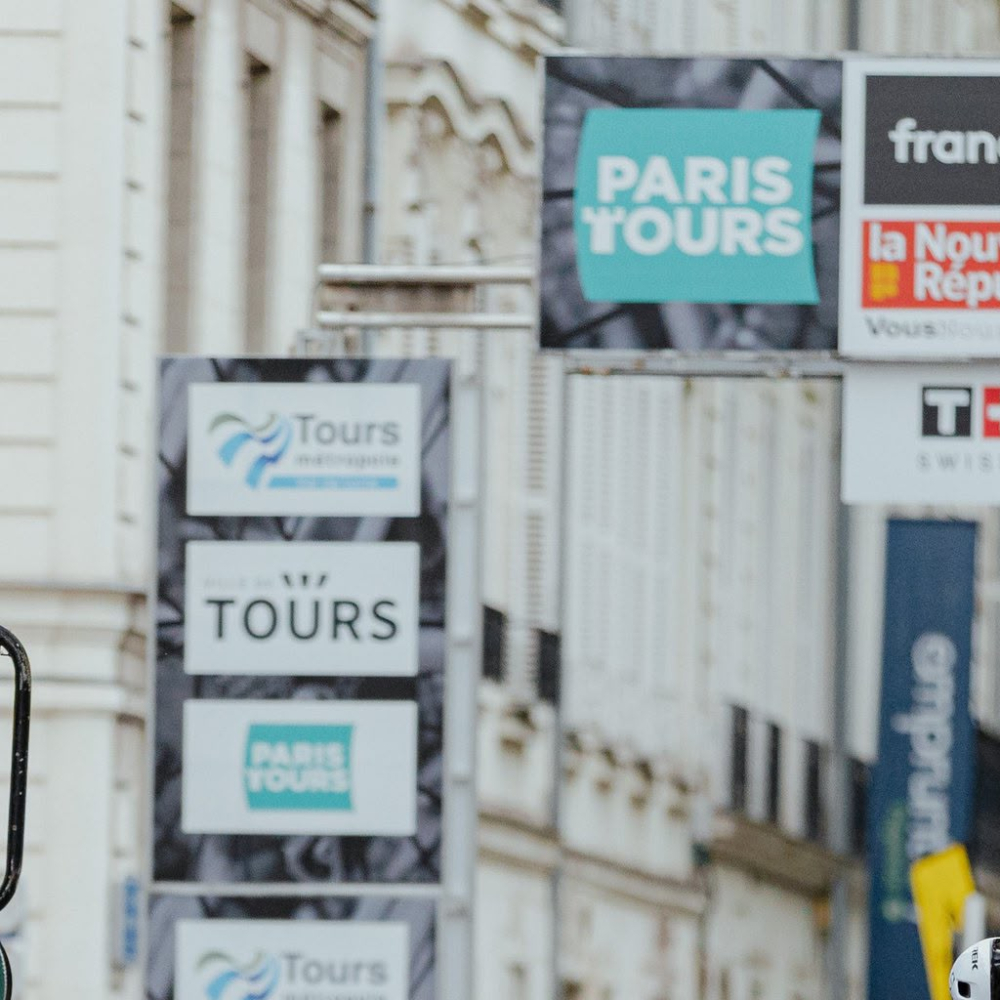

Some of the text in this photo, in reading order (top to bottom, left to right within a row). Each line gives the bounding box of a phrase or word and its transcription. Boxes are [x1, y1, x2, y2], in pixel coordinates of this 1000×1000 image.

[596, 155, 794, 203] PARIS
[582, 206, 805, 257] TOURS
[869, 222, 908, 262] la
[291, 413, 400, 446] Tours
[205, 598, 398, 641] TOURS
[250, 742, 345, 767] PARIS
[246, 767, 348, 795] TOURS
[281, 952, 389, 988] Tours
